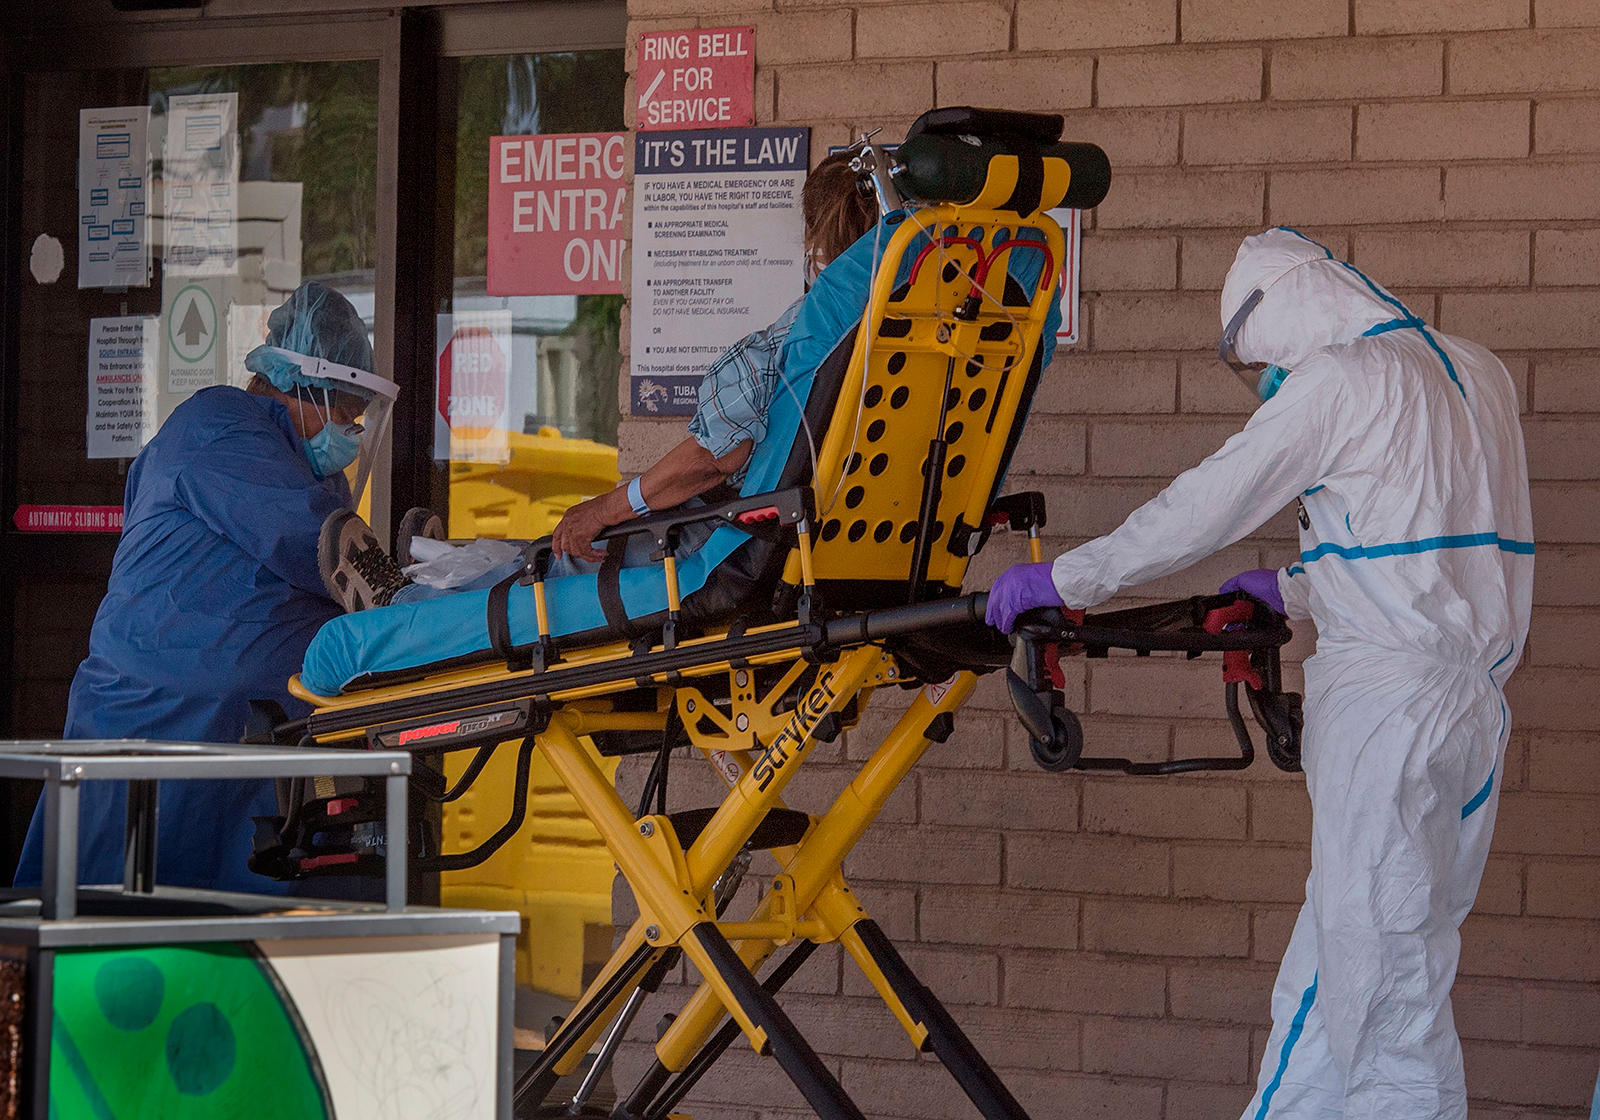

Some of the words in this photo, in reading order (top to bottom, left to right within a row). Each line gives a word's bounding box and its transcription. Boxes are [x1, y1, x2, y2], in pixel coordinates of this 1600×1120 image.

[644, 35, 689, 61] RING
[698, 32, 748, 58] BELL
[672, 67, 713, 92] FOR
[647, 97, 731, 125] SERVICE
[644, 140, 685, 167] IT'S
[691, 139, 737, 166] THE
[744, 137, 799, 164] LAW
[644, 182, 650, 190] IF
[652, 181, 666, 190] YOU
[667, 181, 685, 189] HAVE
[686, 181, 692, 189] A
[693, 180, 723, 189] MEDICAL
[724, 180, 767, 188] EMERGENCY
[768, 179, 779, 187] OR
[780, 179, 795, 187] ARE
[644, 194, 651, 202] IN
[653, 193, 677, 202] LABOR,
[679, 193, 693, 201] YOU
[694, 193, 713, 201] HAVE
[715, 192, 728, 200] THE
[729, 192, 750, 200] RIGHT
[752, 191, 761, 199] TO
[762, 190, 794, 199] RECEIVE,
[670, 204, 699, 212] capabilities
[718, 203, 744, 211] hospital's
[664, 220, 703, 228] APPROPRIATE
[704, 220, 729, 228] MEDICAL
[654, 230, 686, 238] SCREENING
[687, 230, 726, 238] EXAMINATION
[688, 249, 723, 257] STABILIZING
[653, 260, 677, 268] (including
[703, 278, 733, 286] TRANSFER
[690, 288, 715, 296] FACILITY
[653, 298, 668, 306] EVEN
[669, 298, 675, 306] IF
[676, 298, 687, 306] YOU
[691, 307, 715, 315] MEDICAL
[716, 307, 749, 315] INSURANCE
[102, 325, 119, 333] Please
[96, 338, 117, 346] Hospital
[118, 337, 139, 345] Through
[99, 349, 117, 358] SOUTH
[118, 348, 144, 357] ENTRANC
[453, 353, 492, 373] RED
[170, 369, 198, 377] AUTOMATIC
[200, 368, 214, 376] DOOR
[637, 364, 650, 372] This
[651, 364, 675, 373] hospital
[96, 374, 132, 384] AMBULANCES
[189, 378, 212, 386] MOVING
[98, 387, 113, 395] Thank
[673, 386, 697, 396] TUBA
[98, 398, 131, 407] Cooperation
[447, 396, 496, 416] ZONE
[107, 422, 115, 430] the
[116, 422, 133, 431] Safety
[28, 511, 72, 526] AUTOMATIC
[75, 512, 105, 527] SLIDING
[753, 671, 836, 793] stryker
